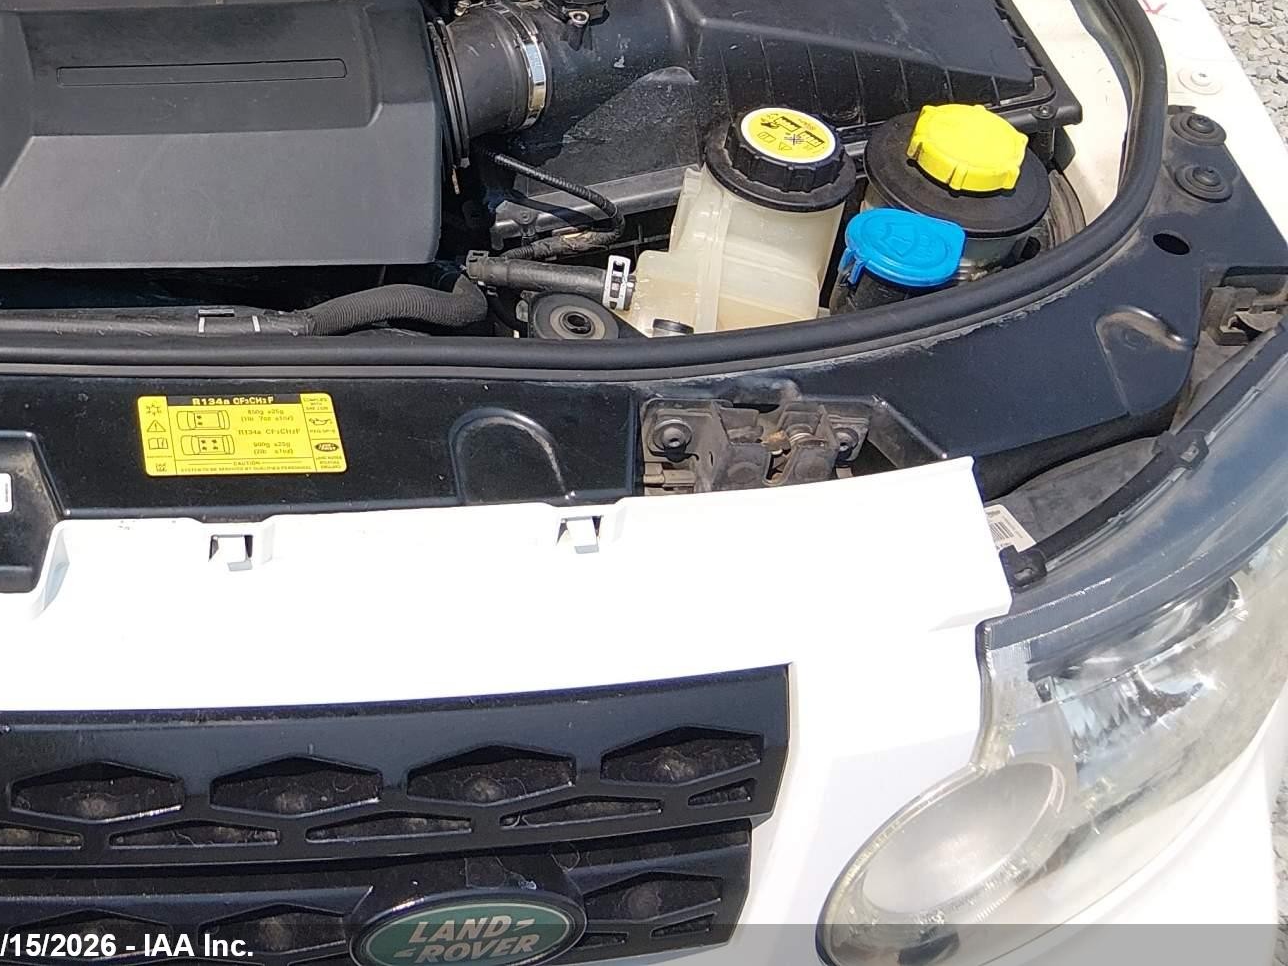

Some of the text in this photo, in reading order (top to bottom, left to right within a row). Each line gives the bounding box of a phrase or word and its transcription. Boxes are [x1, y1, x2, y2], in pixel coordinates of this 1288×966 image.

[192, 398, 231, 406] R134a
[409, 915, 512, 944] LAND
[414, 934, 540, 964] ROVER
